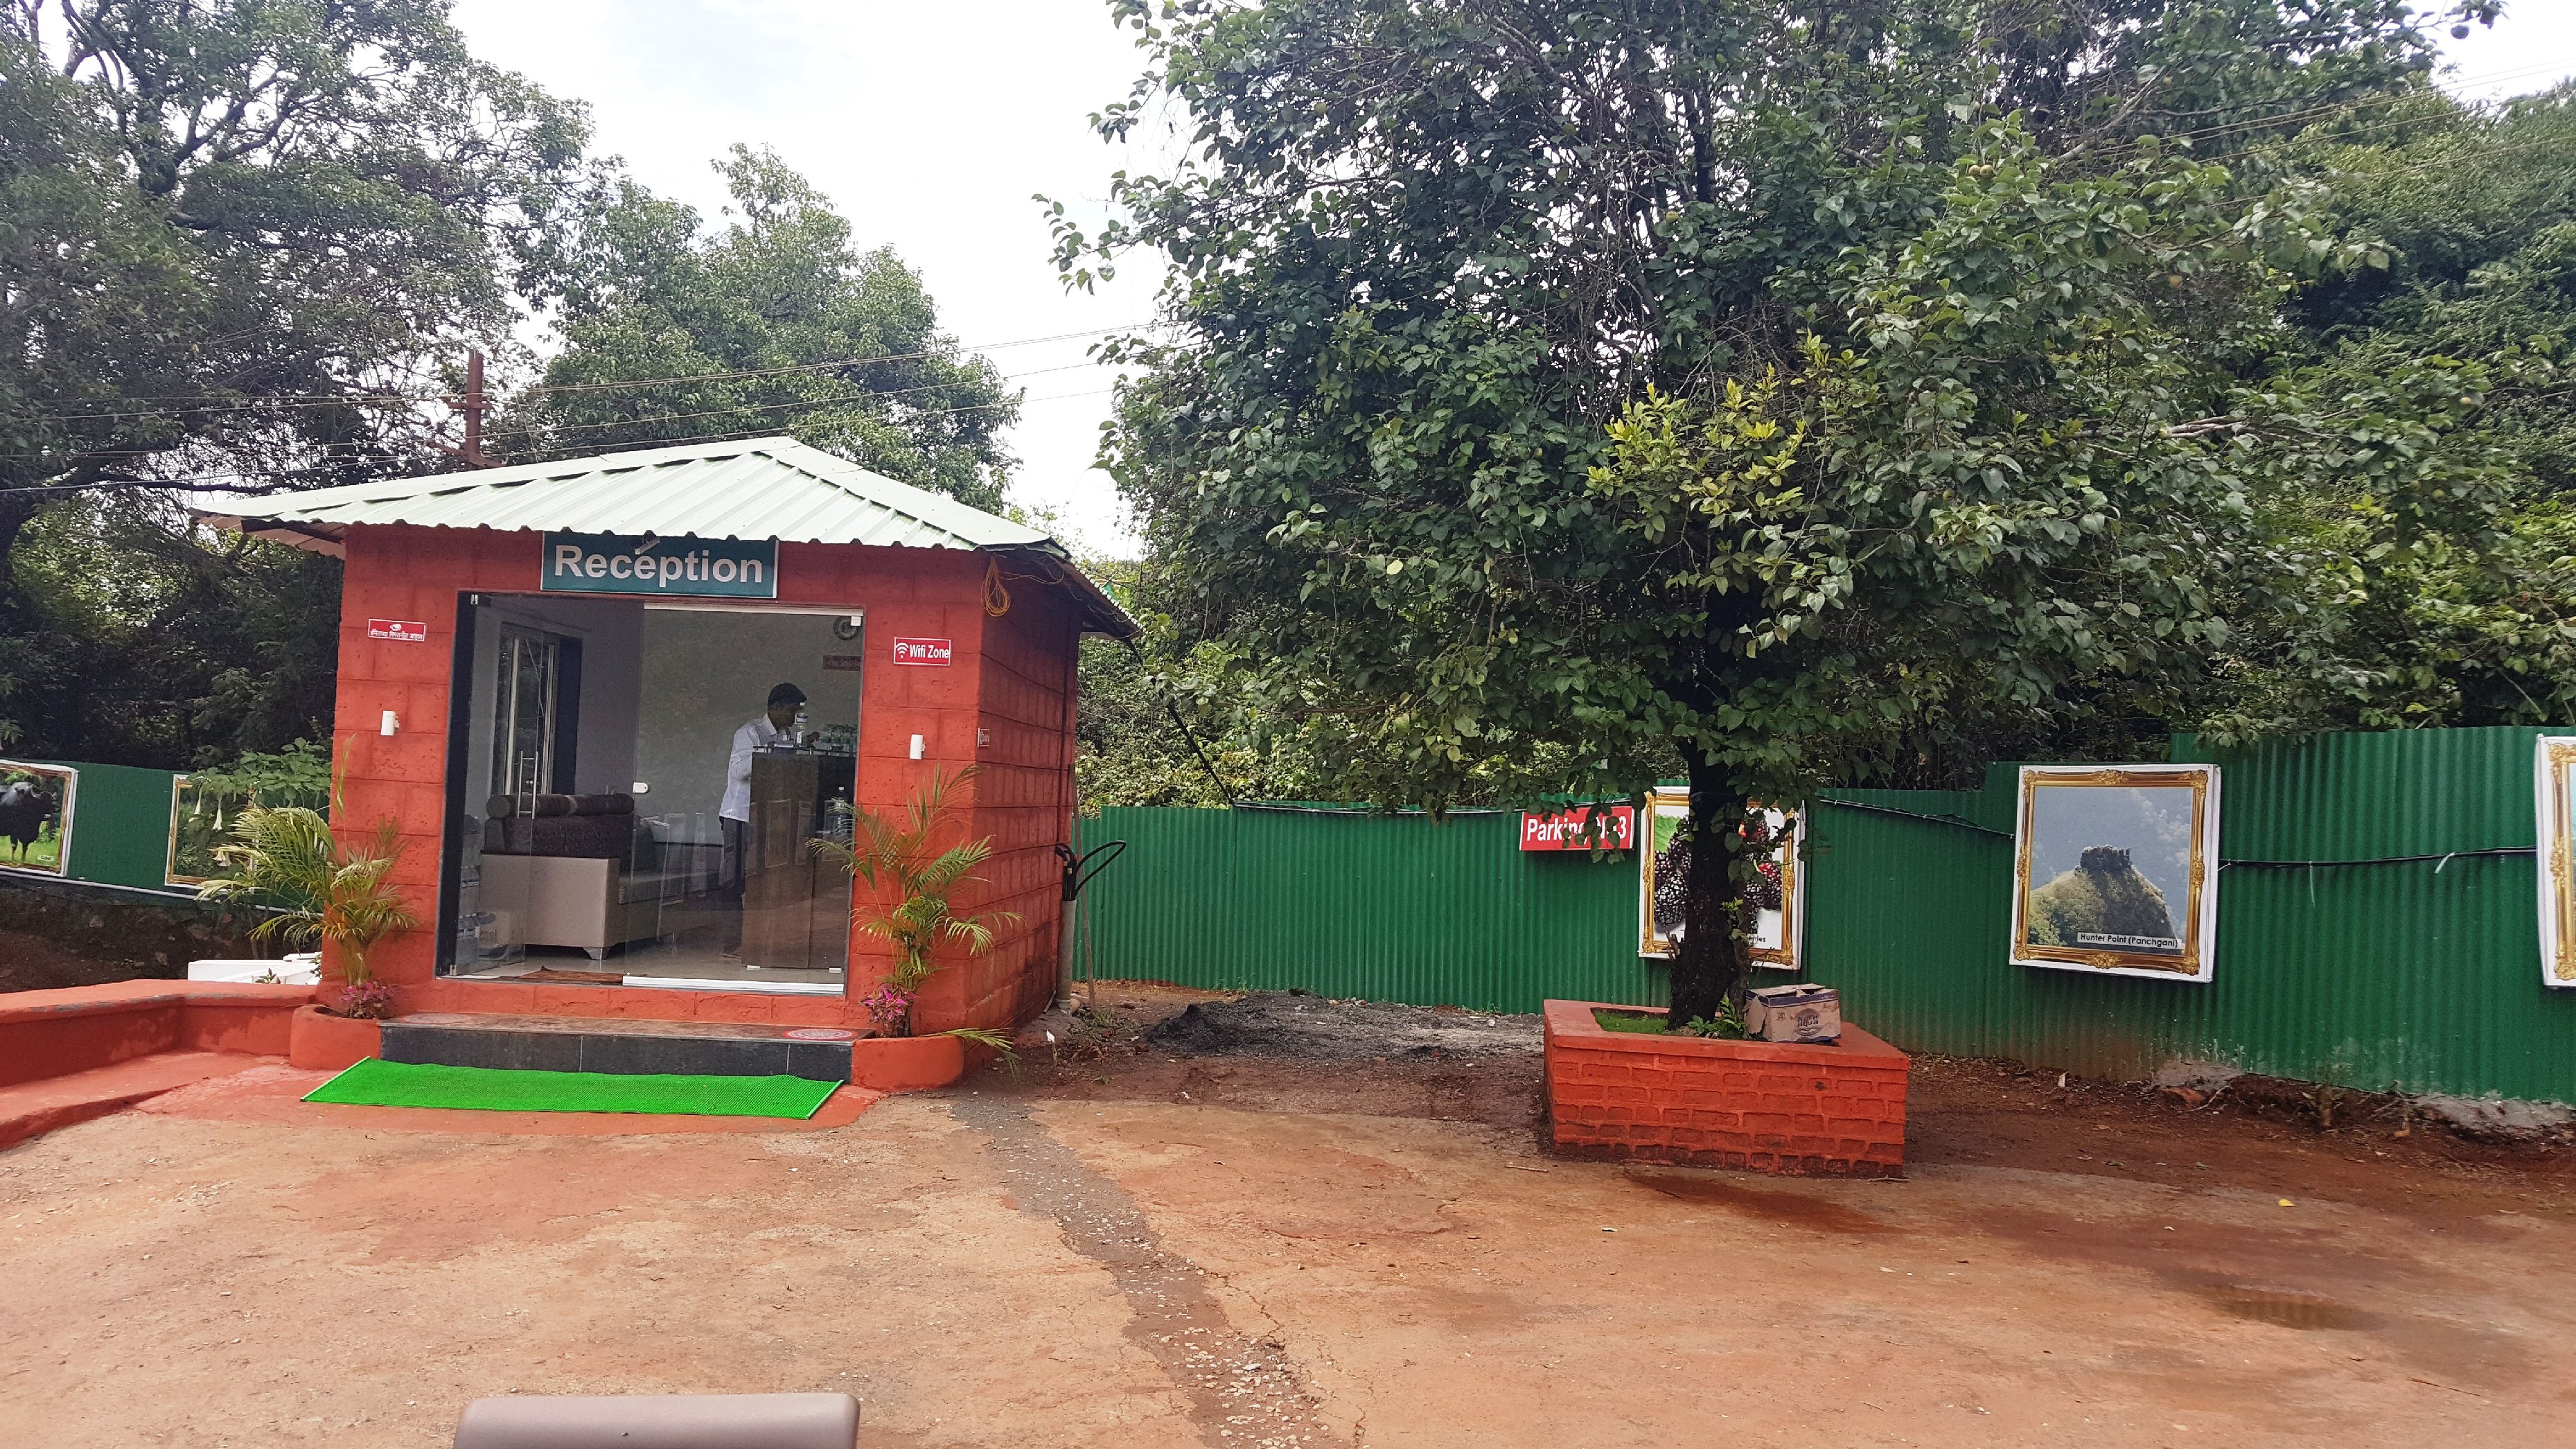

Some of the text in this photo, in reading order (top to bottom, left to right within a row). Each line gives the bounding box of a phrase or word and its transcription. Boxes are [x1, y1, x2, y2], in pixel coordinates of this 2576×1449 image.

[555, 545, 762, 588] Reception
[909, 644, 949, 659] Wifi Zone
[2080, 933, 2178, 948] Hunter Point (Panchgani)
